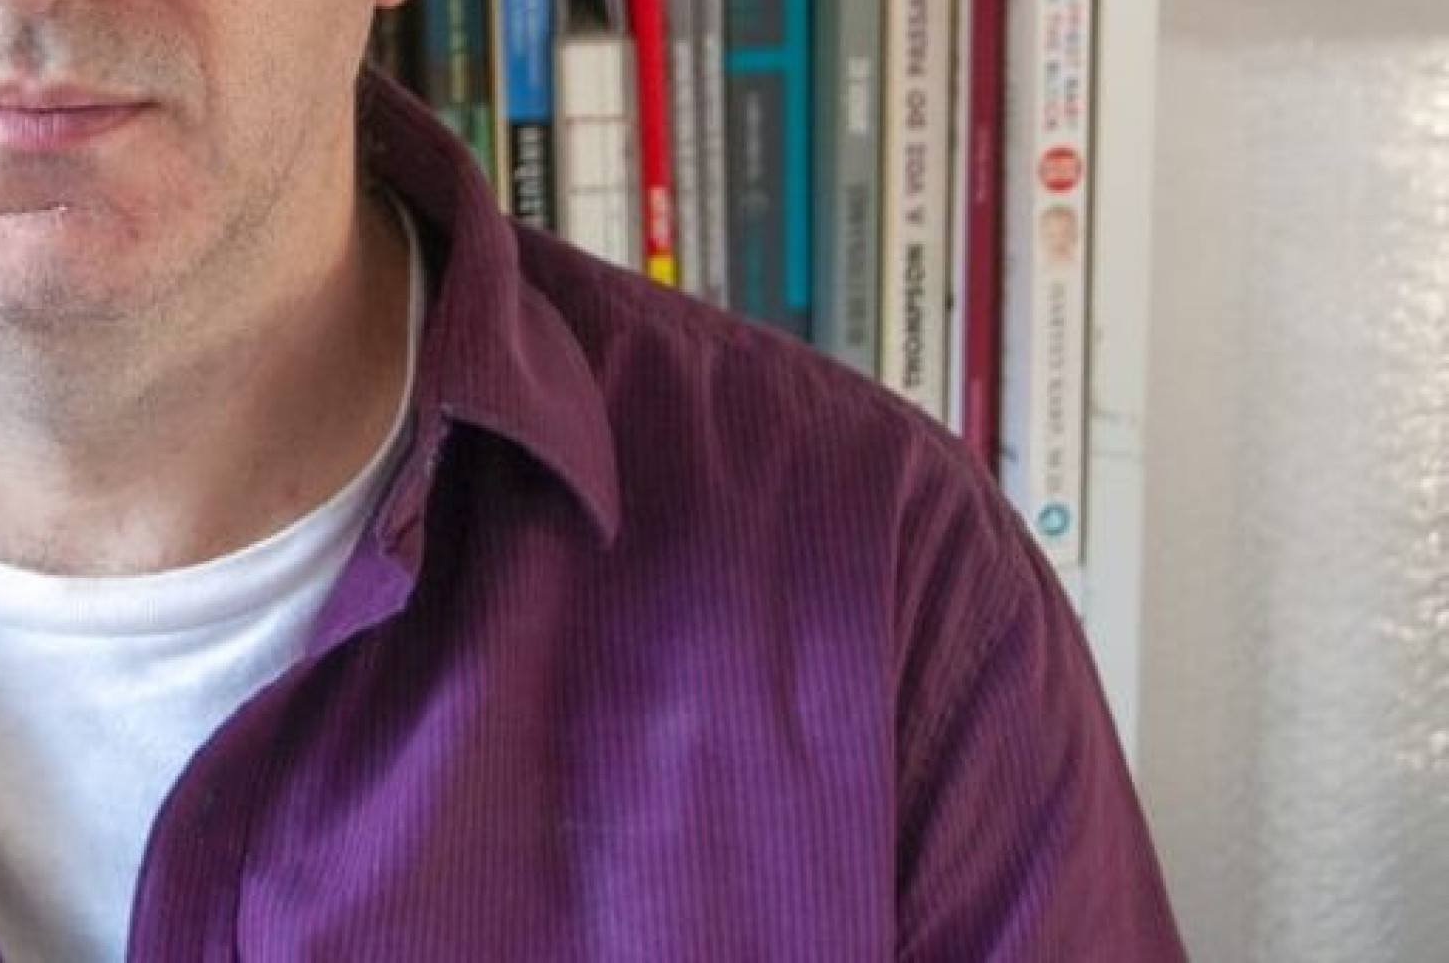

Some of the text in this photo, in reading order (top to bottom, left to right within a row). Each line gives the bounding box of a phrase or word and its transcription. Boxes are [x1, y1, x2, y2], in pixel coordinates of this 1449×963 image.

[906, 91, 927, 129] DO
[905, 144, 927, 194] VOZ
[905, 205, 924, 226] A
[903, 243, 925, 385] THOMPSON
